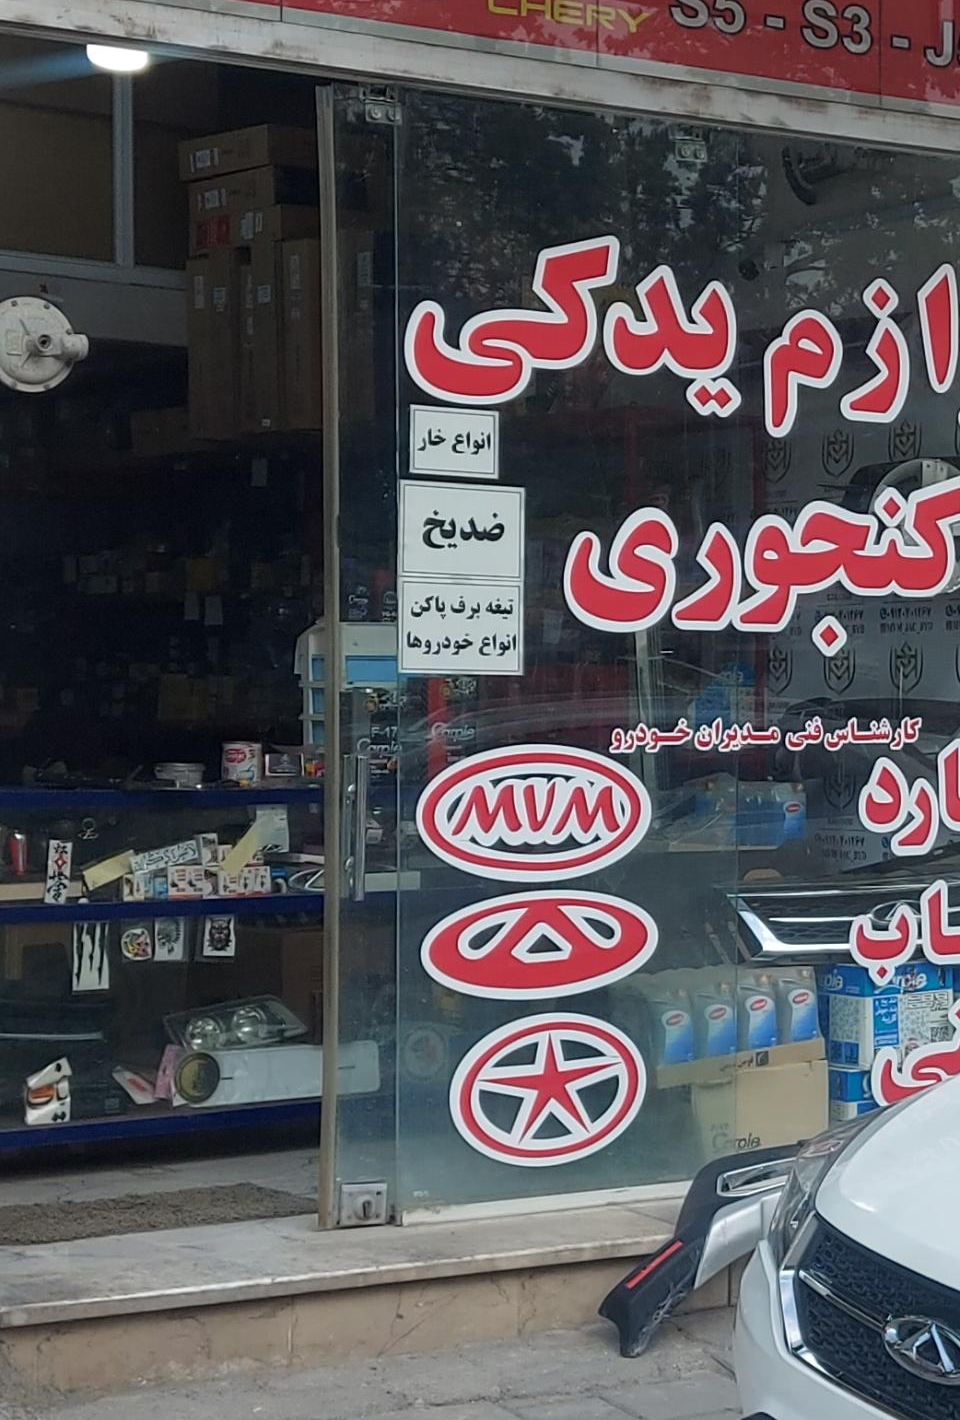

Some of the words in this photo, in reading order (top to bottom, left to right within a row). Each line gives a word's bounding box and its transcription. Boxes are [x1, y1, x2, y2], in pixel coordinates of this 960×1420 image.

[405, 235, 741, 417] یدکی
[417, 428, 447, 451] خار
[451, 430, 492, 455] انواع
[421, 509, 506, 549] ضدیخ
[410, 594, 446, 620] پاکن
[449, 594, 481, 620] برف
[485, 598, 514, 620] تیغه
[406, 631, 474, 656] خودروها
[478, 633, 517, 657] انواع
[609, 718, 693, 754] خودرو
[694, 717, 780, 753] مدیران
[785, 716, 822, 751] فنی
[825, 717, 923, 751] کارشناس
[451, 781, 621, 836] MVM
